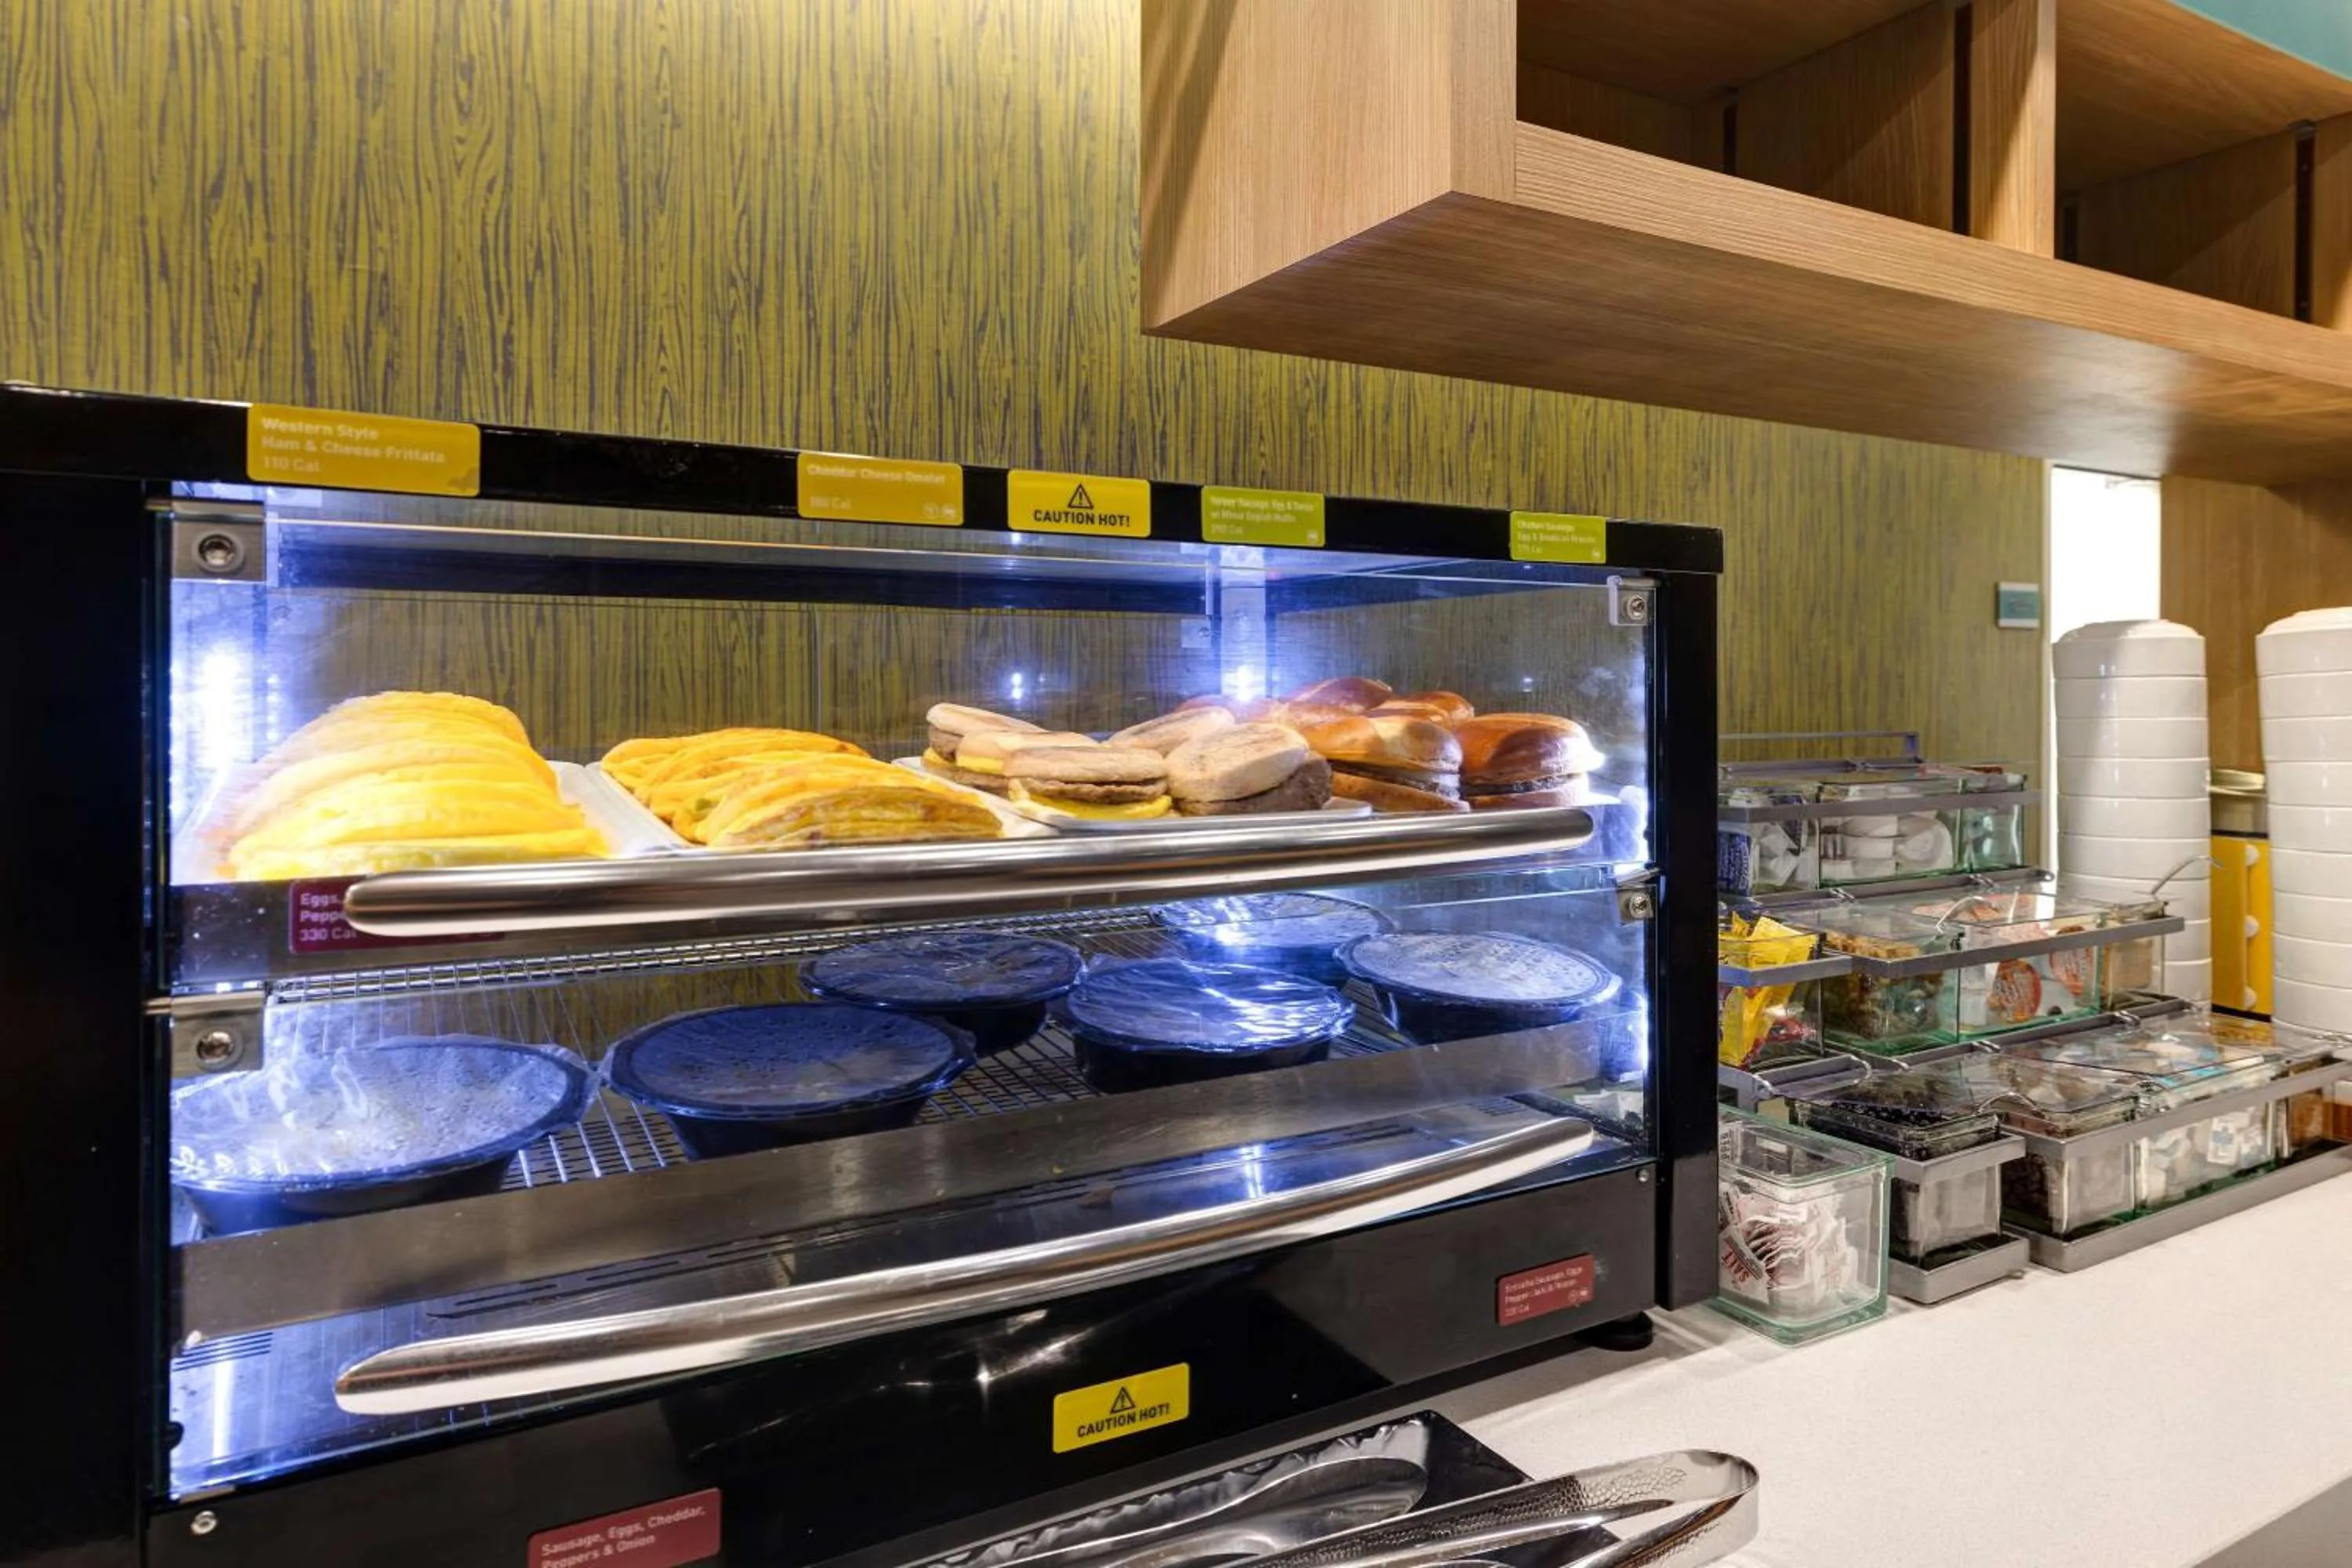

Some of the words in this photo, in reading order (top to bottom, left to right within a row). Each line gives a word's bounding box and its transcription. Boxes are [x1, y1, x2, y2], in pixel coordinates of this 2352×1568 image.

[261, 416, 334, 437] Western
[338, 423, 379, 441] Style
[261, 436, 300, 451] Ham
[305, 441, 317, 453] &
[321, 441, 381, 459] Cheese
[385, 446, 445, 463] Frittata
[1033, 509, 1094, 524] CAUTION
[1099, 514, 1130, 528] HOT!
[332, 926, 357, 939] Cal
[1722, 1250, 1750, 1283] SALT
[1077, 1411, 1137, 1439] CAUTION
[1139, 1402, 1171, 1421] HOT!
[542, 1532, 606, 1557] Sausage,
[608, 1522, 645, 1540] Eggs,
[647, 1504, 706, 1528] Cheddar,
[541, 1548, 601, 1568] Peppers
[602, 1544, 613, 1556] &
[616, 1534, 656, 1552] Onion
